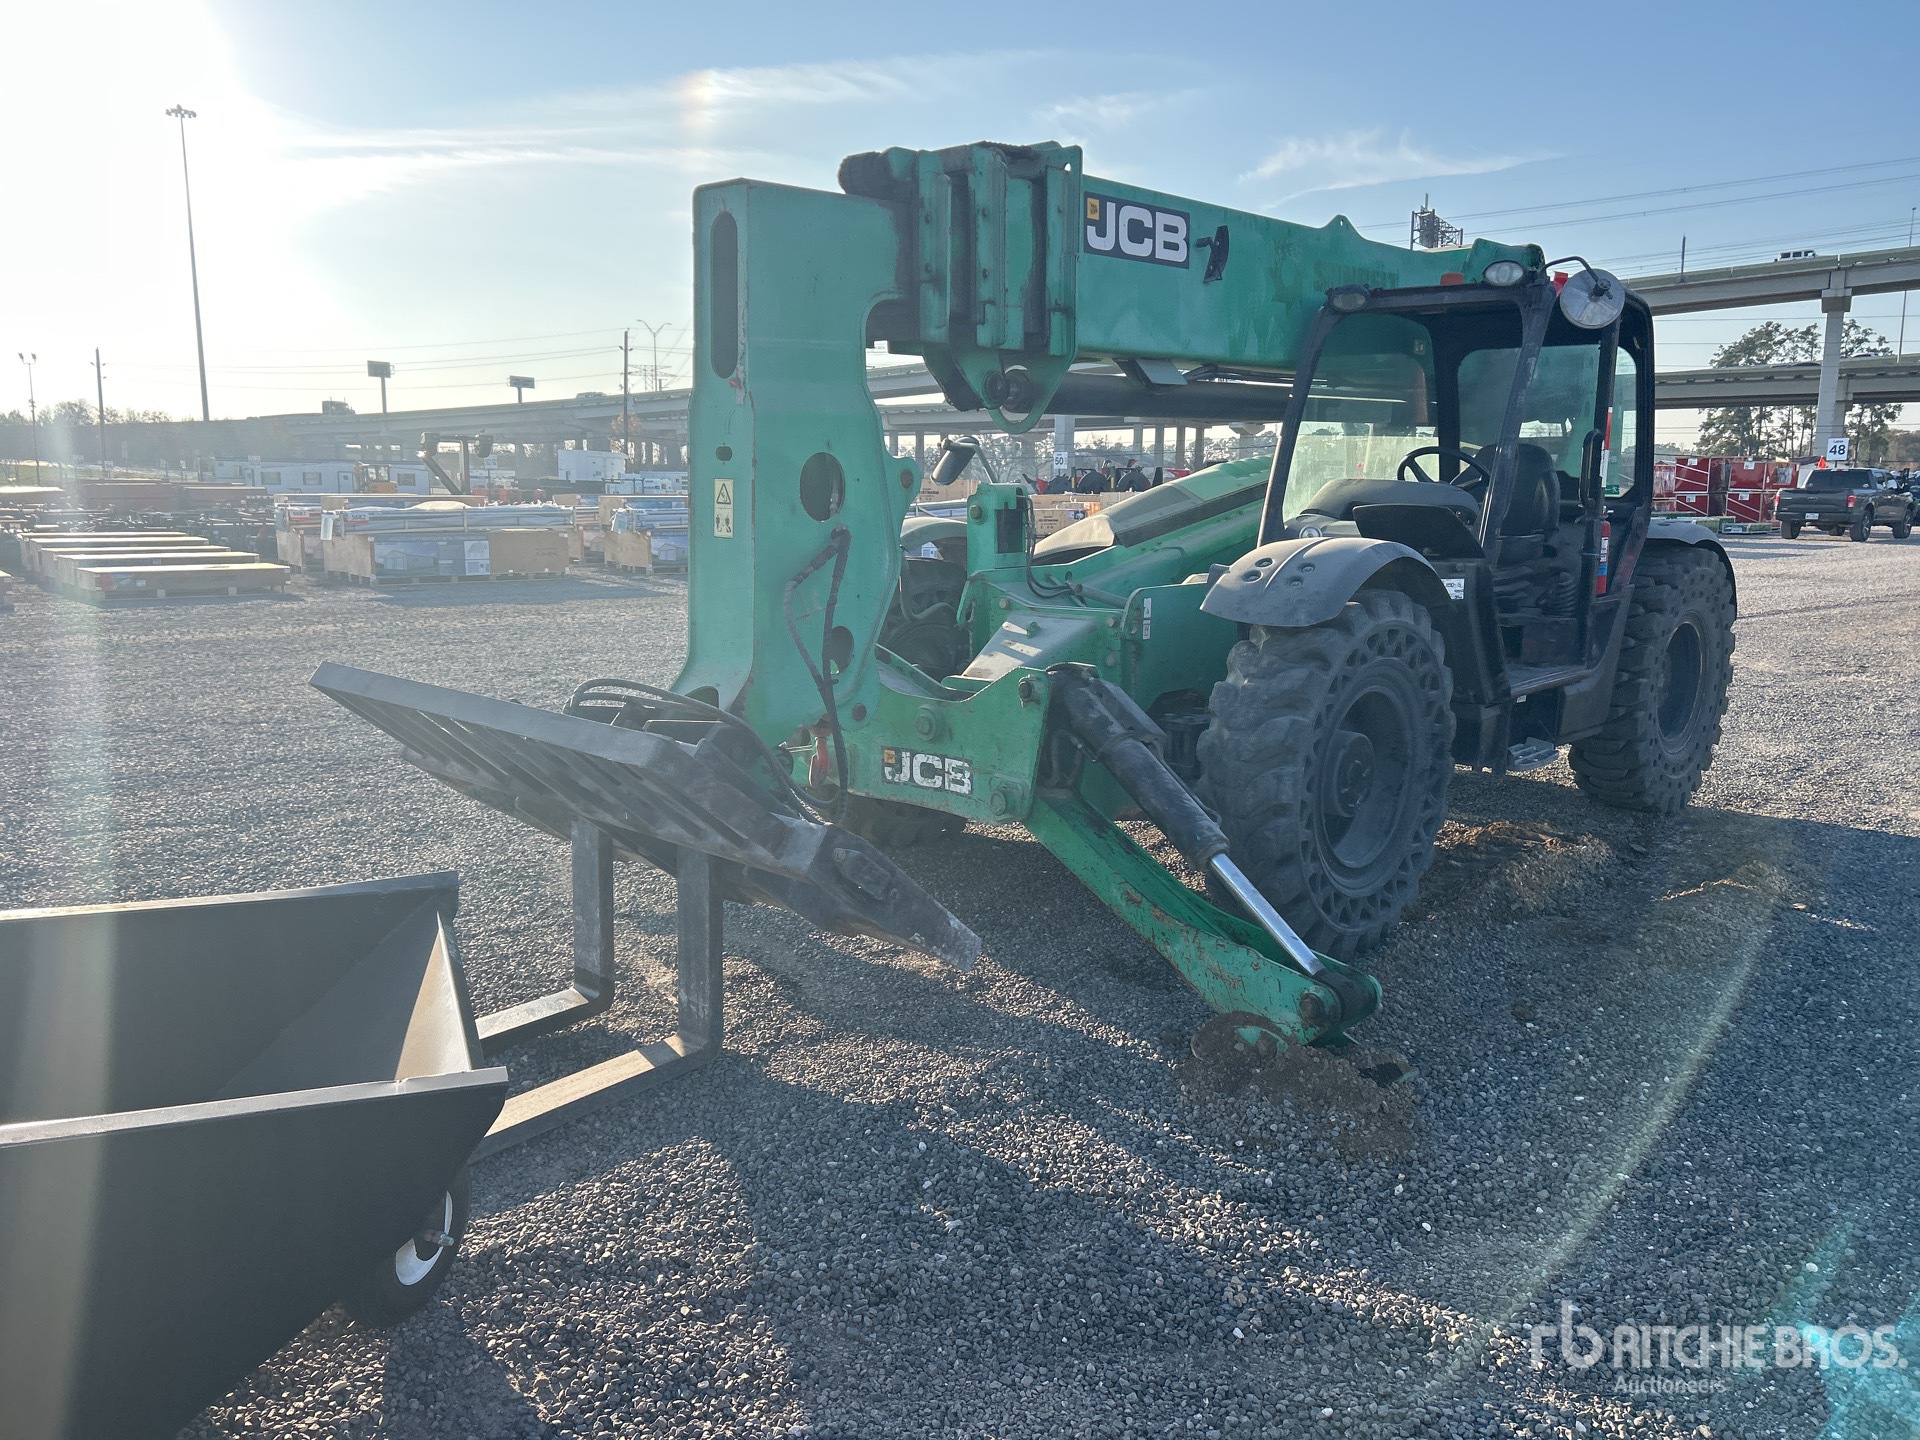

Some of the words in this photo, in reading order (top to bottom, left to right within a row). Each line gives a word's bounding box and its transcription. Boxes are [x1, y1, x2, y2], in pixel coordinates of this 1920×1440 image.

[1086, 201, 1188, 263] JCB
[1055, 457, 1064, 465] 50
[1829, 444, 1846, 455] 48
[884, 751, 972, 795] JCB
